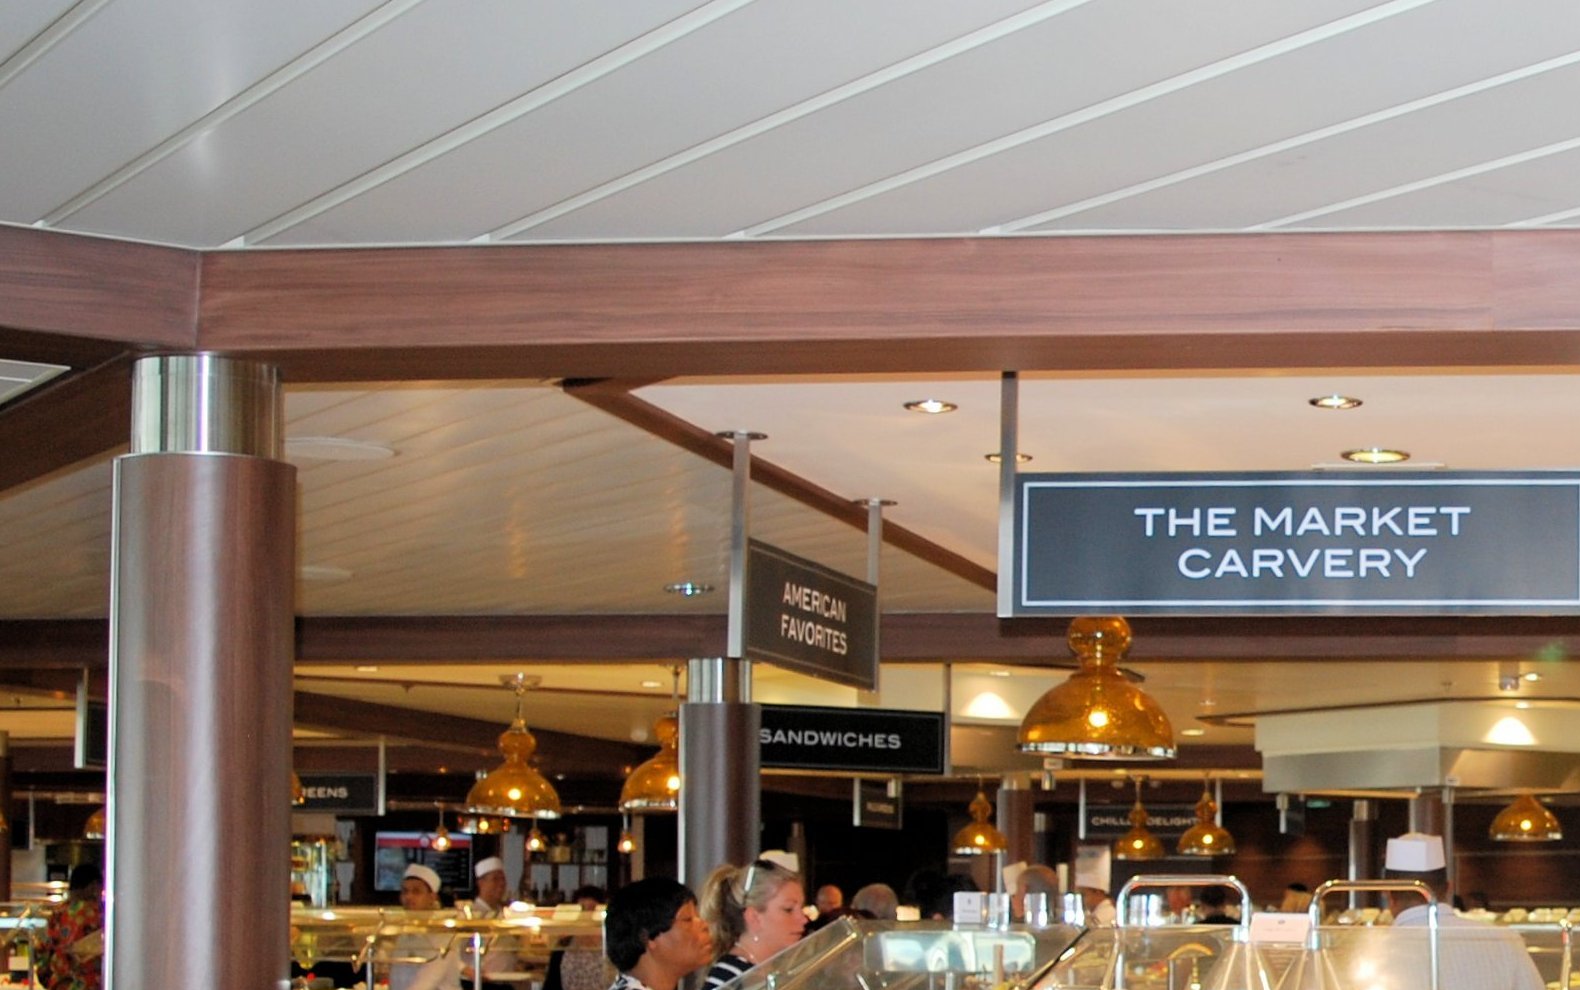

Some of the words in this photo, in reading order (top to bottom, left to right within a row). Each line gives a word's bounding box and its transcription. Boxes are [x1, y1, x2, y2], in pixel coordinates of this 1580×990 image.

[1133, 507, 1237, 537] THE
[1253, 506, 1472, 537] MARKET
[1177, 548, 1428, 579] CARVERY
[782, 582, 847, 623] AMERICAN
[781, 614, 848, 655] FAVORITES
[760, 729, 902, 749] SANDWICHES
